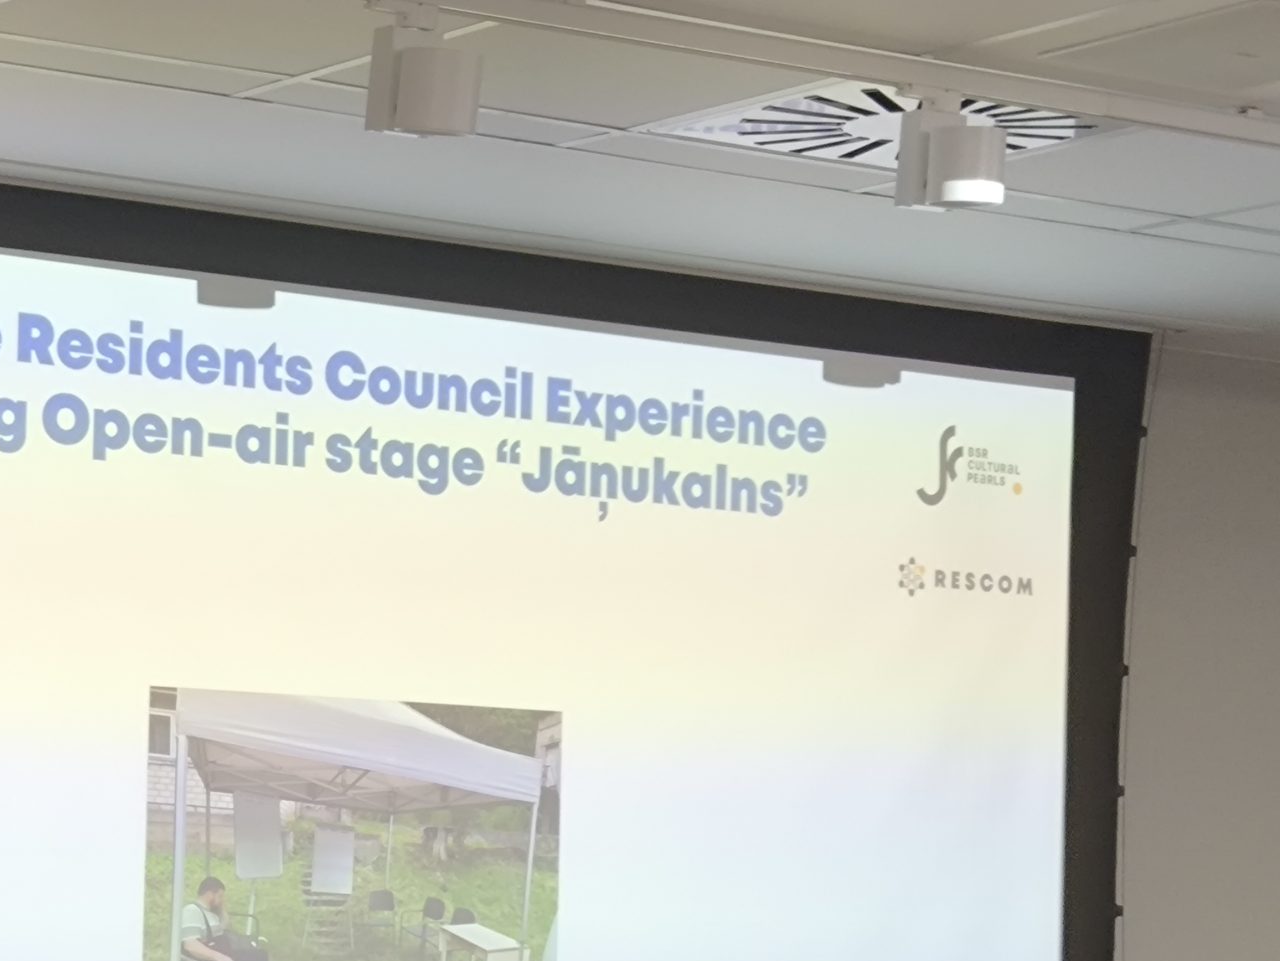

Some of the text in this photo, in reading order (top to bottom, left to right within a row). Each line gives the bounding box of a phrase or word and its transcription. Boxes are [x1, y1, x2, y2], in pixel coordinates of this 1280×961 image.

[16, 311, 314, 396] Residents
[324, 349, 534, 422] Council
[545, 376, 828, 454] Experience
[42, 392, 315, 468] Open-air
[325, 425, 485, 496] stage
[496, 438, 808, 522] “Jāņukalns”
[968, 446, 989, 459] BSR
[968, 459, 1021, 476] CULTURAL
[967, 472, 1007, 487] PEARLS
[934, 569, 1034, 596] RESCOM
